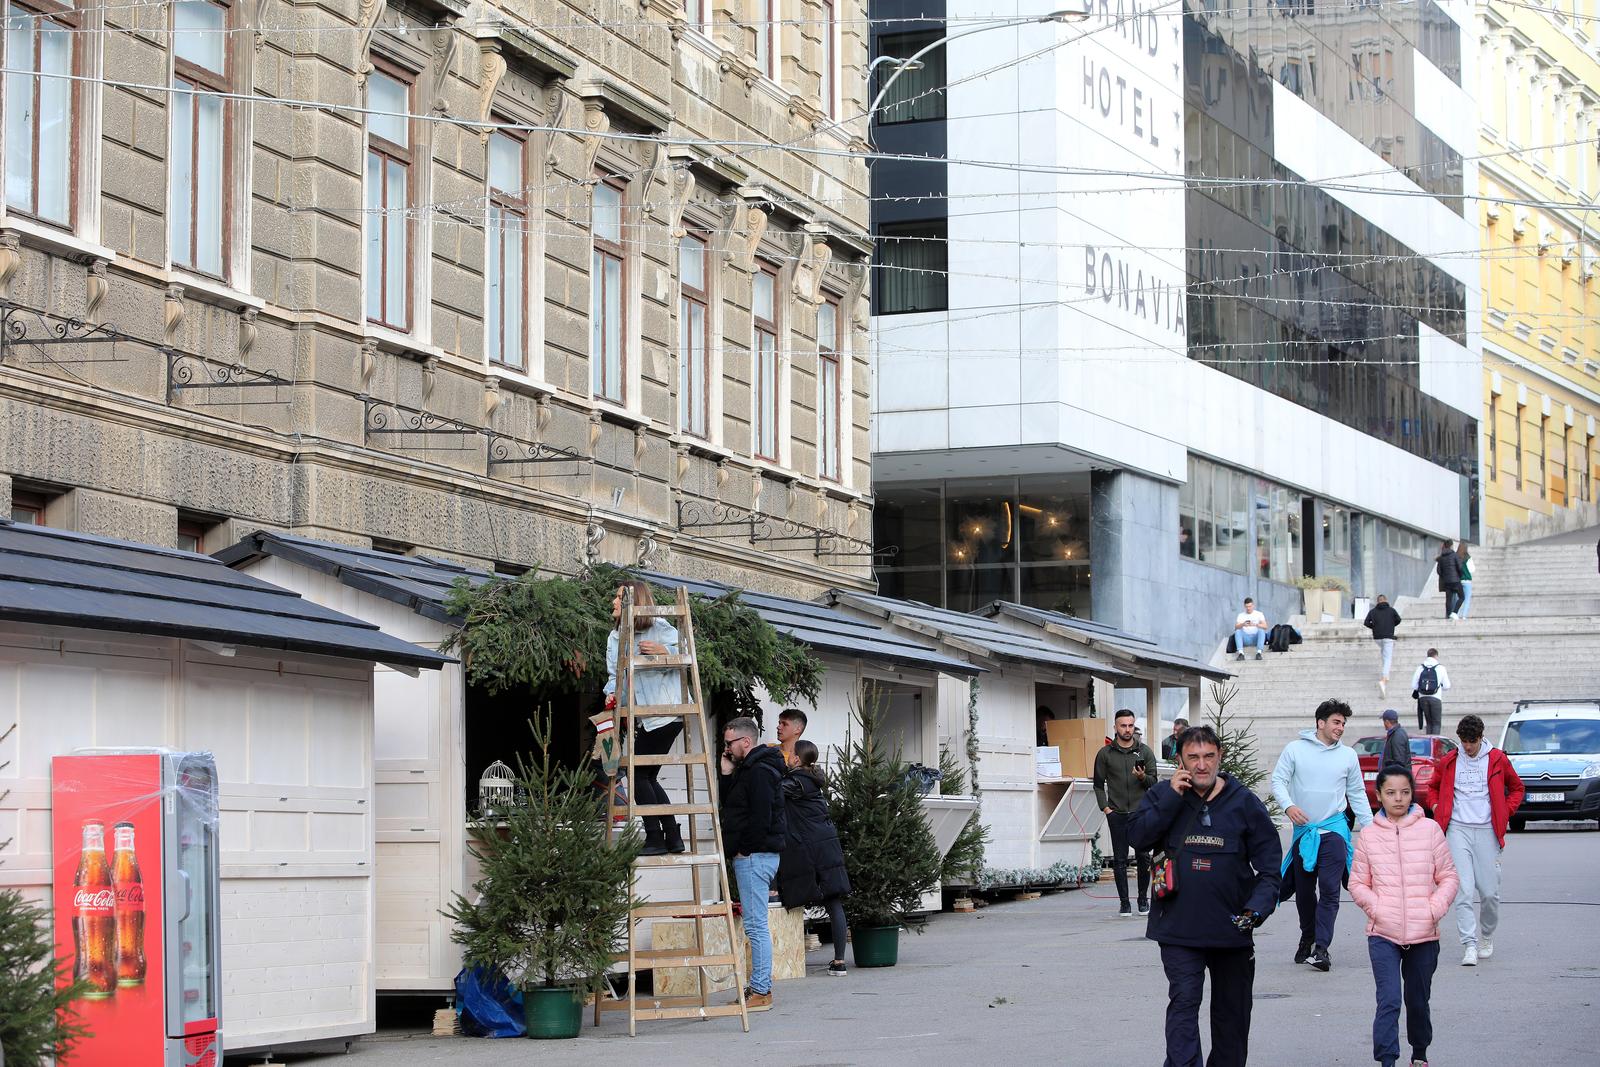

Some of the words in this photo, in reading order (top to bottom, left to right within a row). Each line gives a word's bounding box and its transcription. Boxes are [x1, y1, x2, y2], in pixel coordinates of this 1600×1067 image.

[1083, 55, 1159, 148] HOTEL
[1085, 245, 1185, 336] BONAVIA
[74, 889, 115, 907] Coca-Cola
